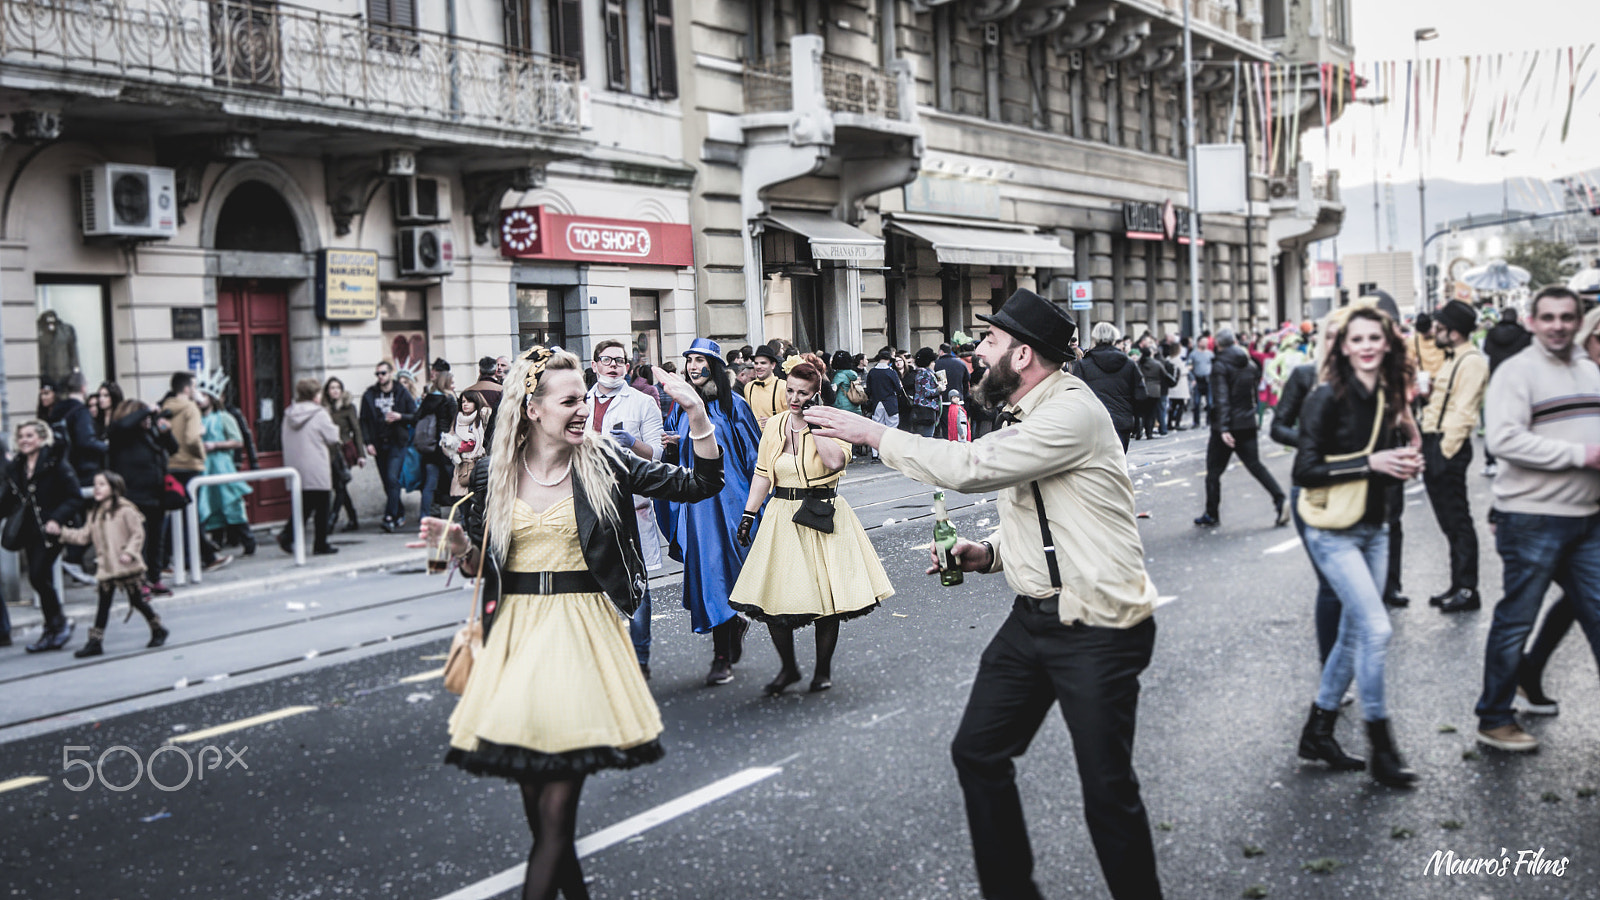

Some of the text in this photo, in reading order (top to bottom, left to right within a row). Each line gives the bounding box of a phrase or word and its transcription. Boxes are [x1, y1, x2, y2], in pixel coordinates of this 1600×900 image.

[573, 228, 636, 250] TOP SHOP
[830, 245, 867, 257] PHANAS PUB
